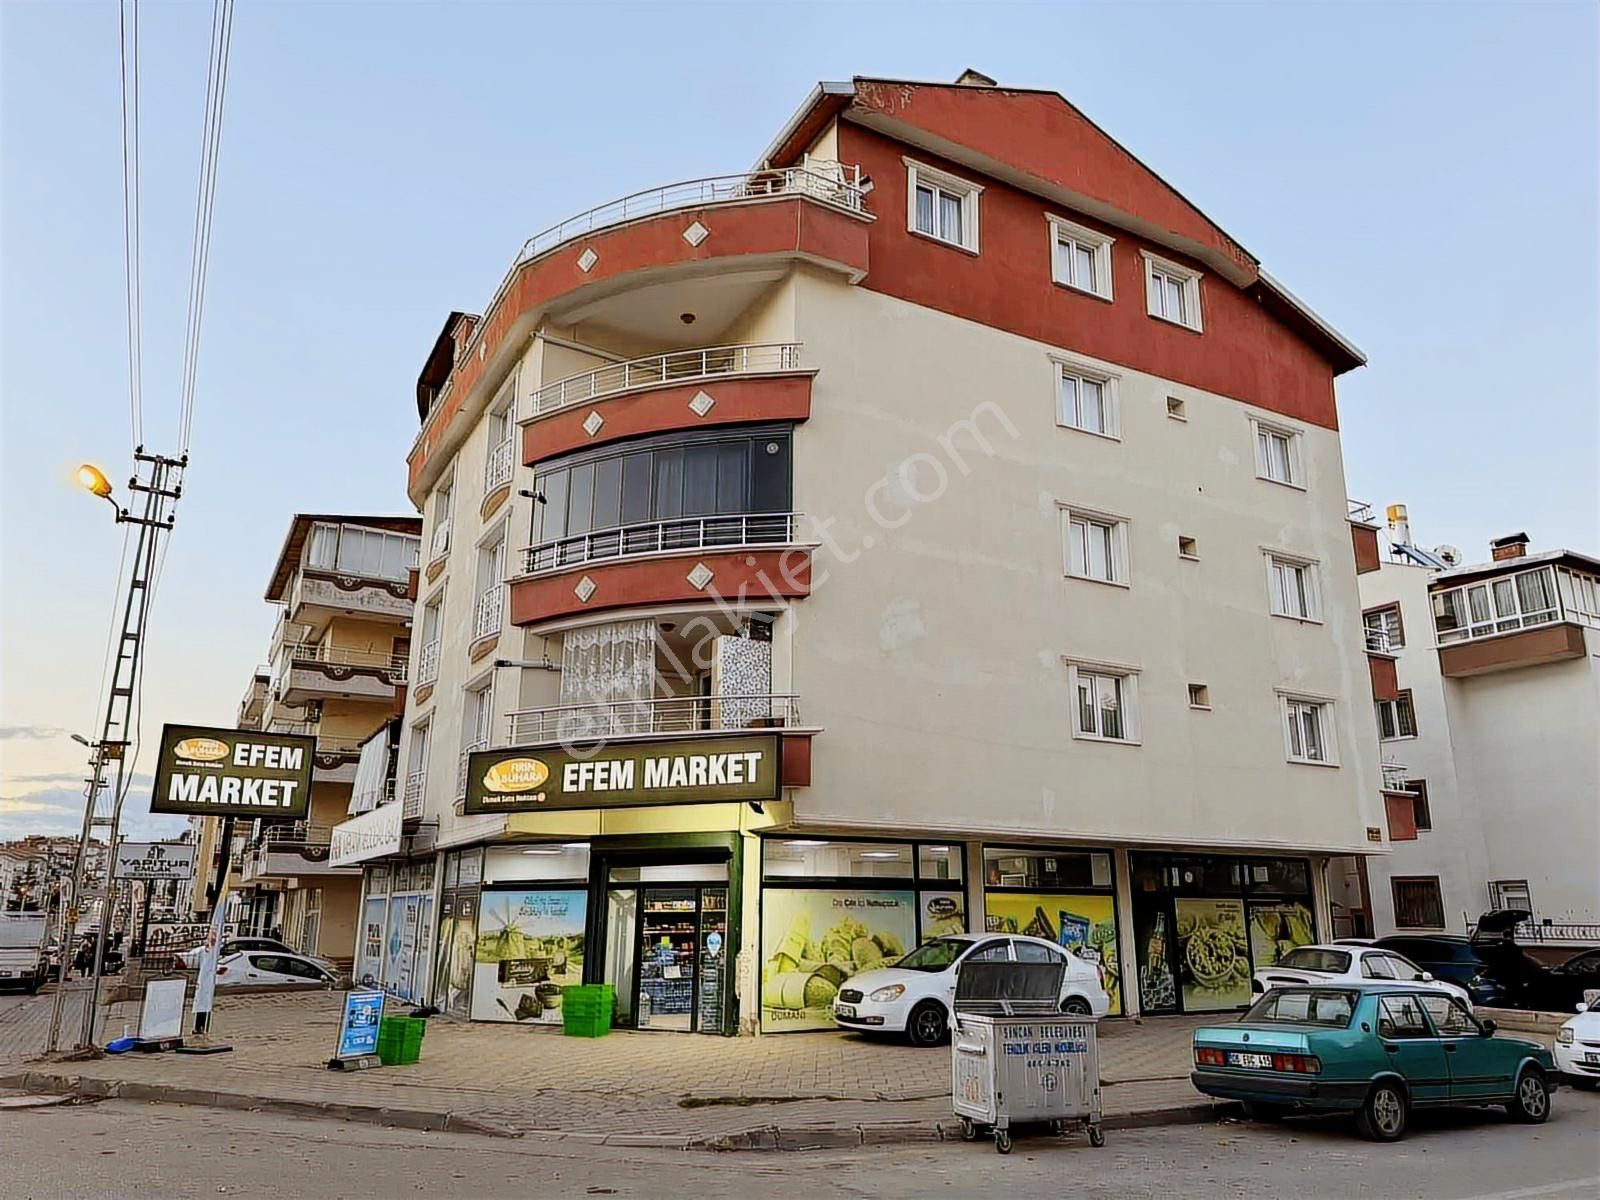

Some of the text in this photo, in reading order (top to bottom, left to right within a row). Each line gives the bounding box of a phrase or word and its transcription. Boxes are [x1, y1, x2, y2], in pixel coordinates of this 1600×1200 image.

[233, 742, 303, 770] EFEM
[562, 751, 763, 793] EFEM MARKET
[168, 773, 298, 807] MARKET
[120, 858, 189, 868] YAPITUR
